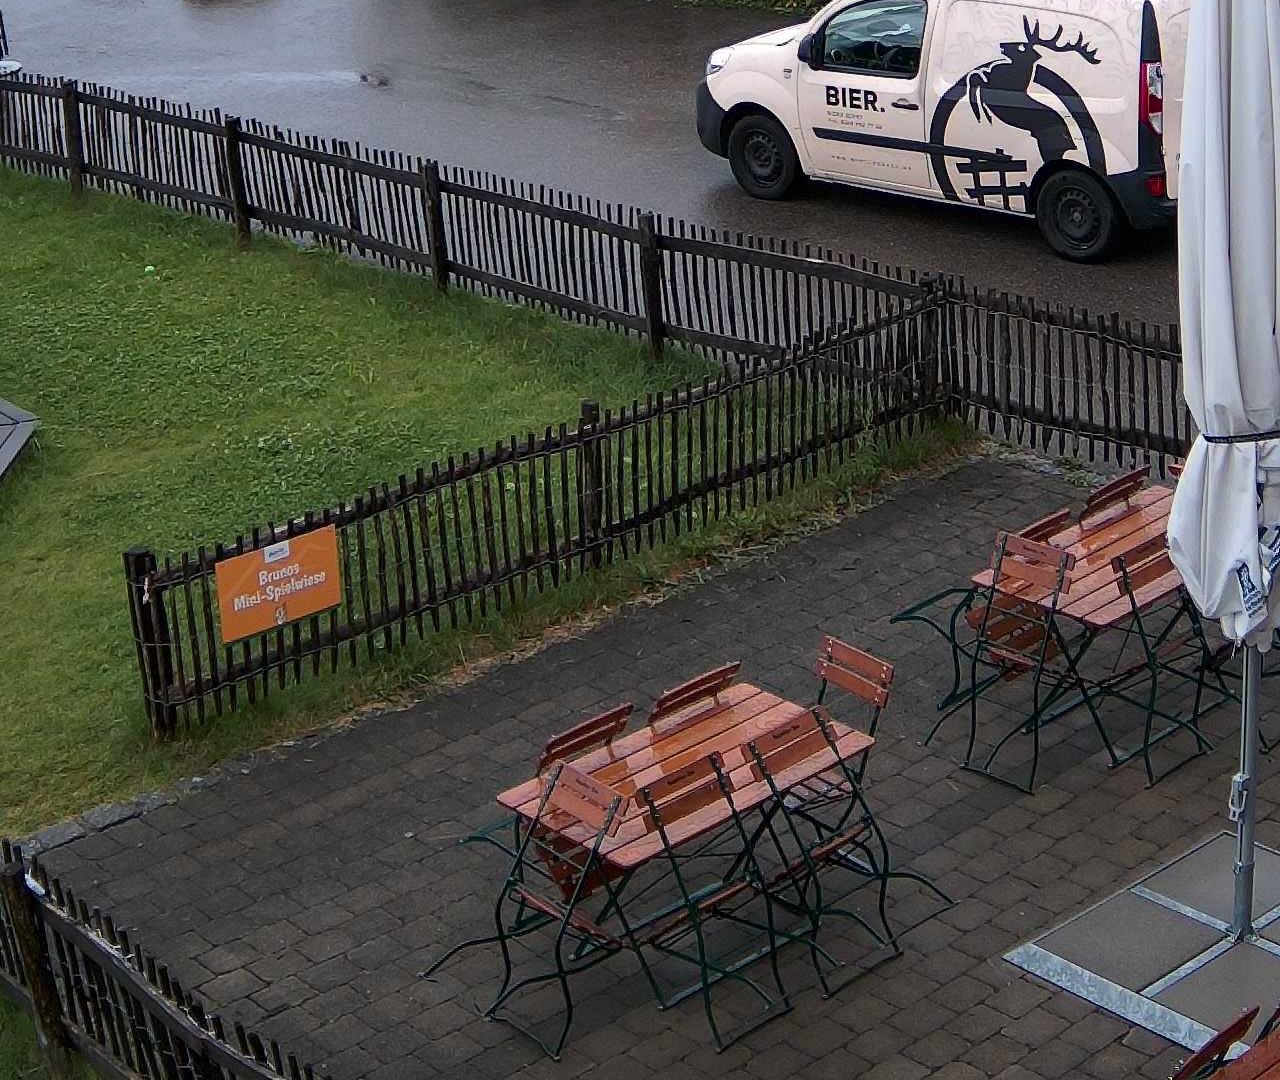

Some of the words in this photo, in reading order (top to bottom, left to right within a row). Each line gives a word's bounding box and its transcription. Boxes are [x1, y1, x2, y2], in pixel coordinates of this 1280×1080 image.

[825, 85, 886, 113] BIER.
[258, 563, 300, 587] Brunos
[233, 571, 326, 612] Mini-Spielwiese
